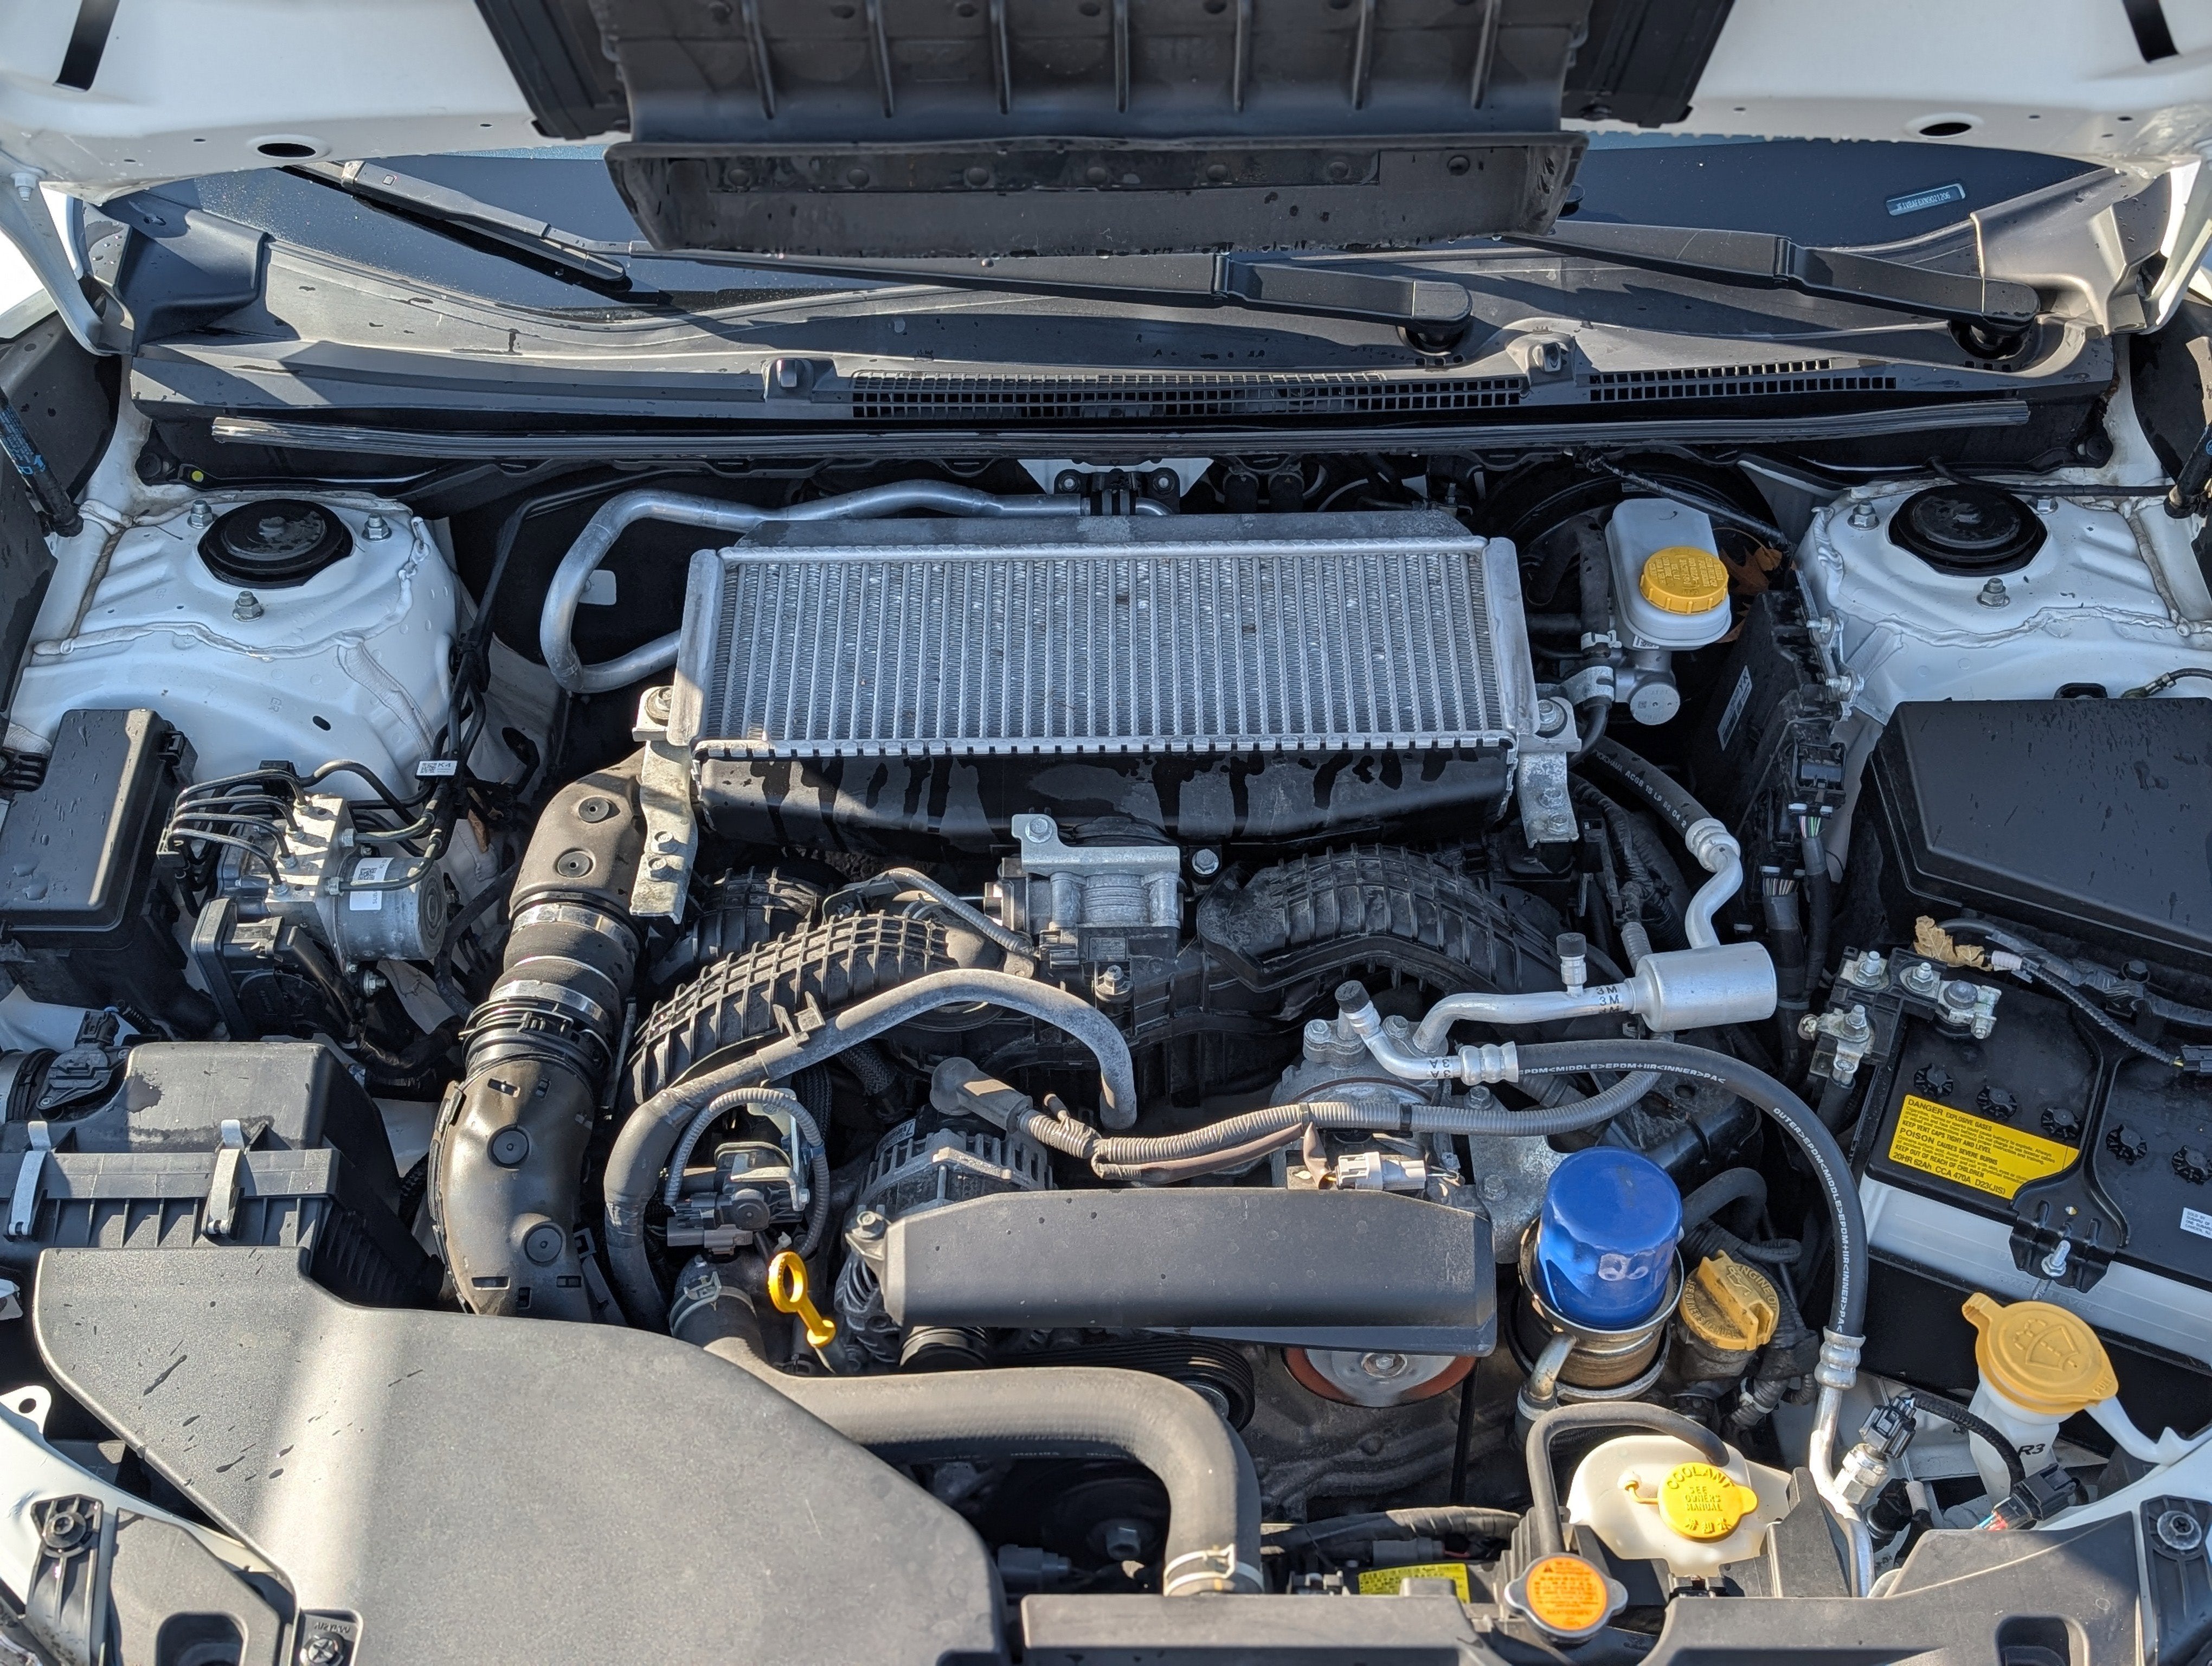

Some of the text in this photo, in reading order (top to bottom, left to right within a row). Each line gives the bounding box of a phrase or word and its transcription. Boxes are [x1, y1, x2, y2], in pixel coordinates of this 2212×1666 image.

[1907, 1098, 1944, 1116] DANGER
[1899, 1126, 1935, 1144] POISON
[1901, 1119, 1916, 1129] KEEP
[1930, 1128, 1946, 1138] CAPS
[1962, 1139, 1975, 1148] AND
[1974, 1143, 1992, 1154] LEVEL
[1894, 1143, 1909, 1153] KEEP
[1909, 1148, 1921, 1157] OUT
[1920, 1151, 1930, 1160] OF
[1947, 1161, 1956, 1169] OF
[1892, 1150, 1913, 1164] 20HR
[1912, 1157, 1933, 1170] 62Ah
[1934, 1164, 1953, 1177] CCA
[1952, 1170, 1972, 1184] 470A
[2018, 1443, 2046, 1456] R3
[1667, 1466, 1735, 1490] COOLANT
[1689, 1486, 1707, 1494] SEE
[1687, 1503, 1724, 1511] MANUAL
